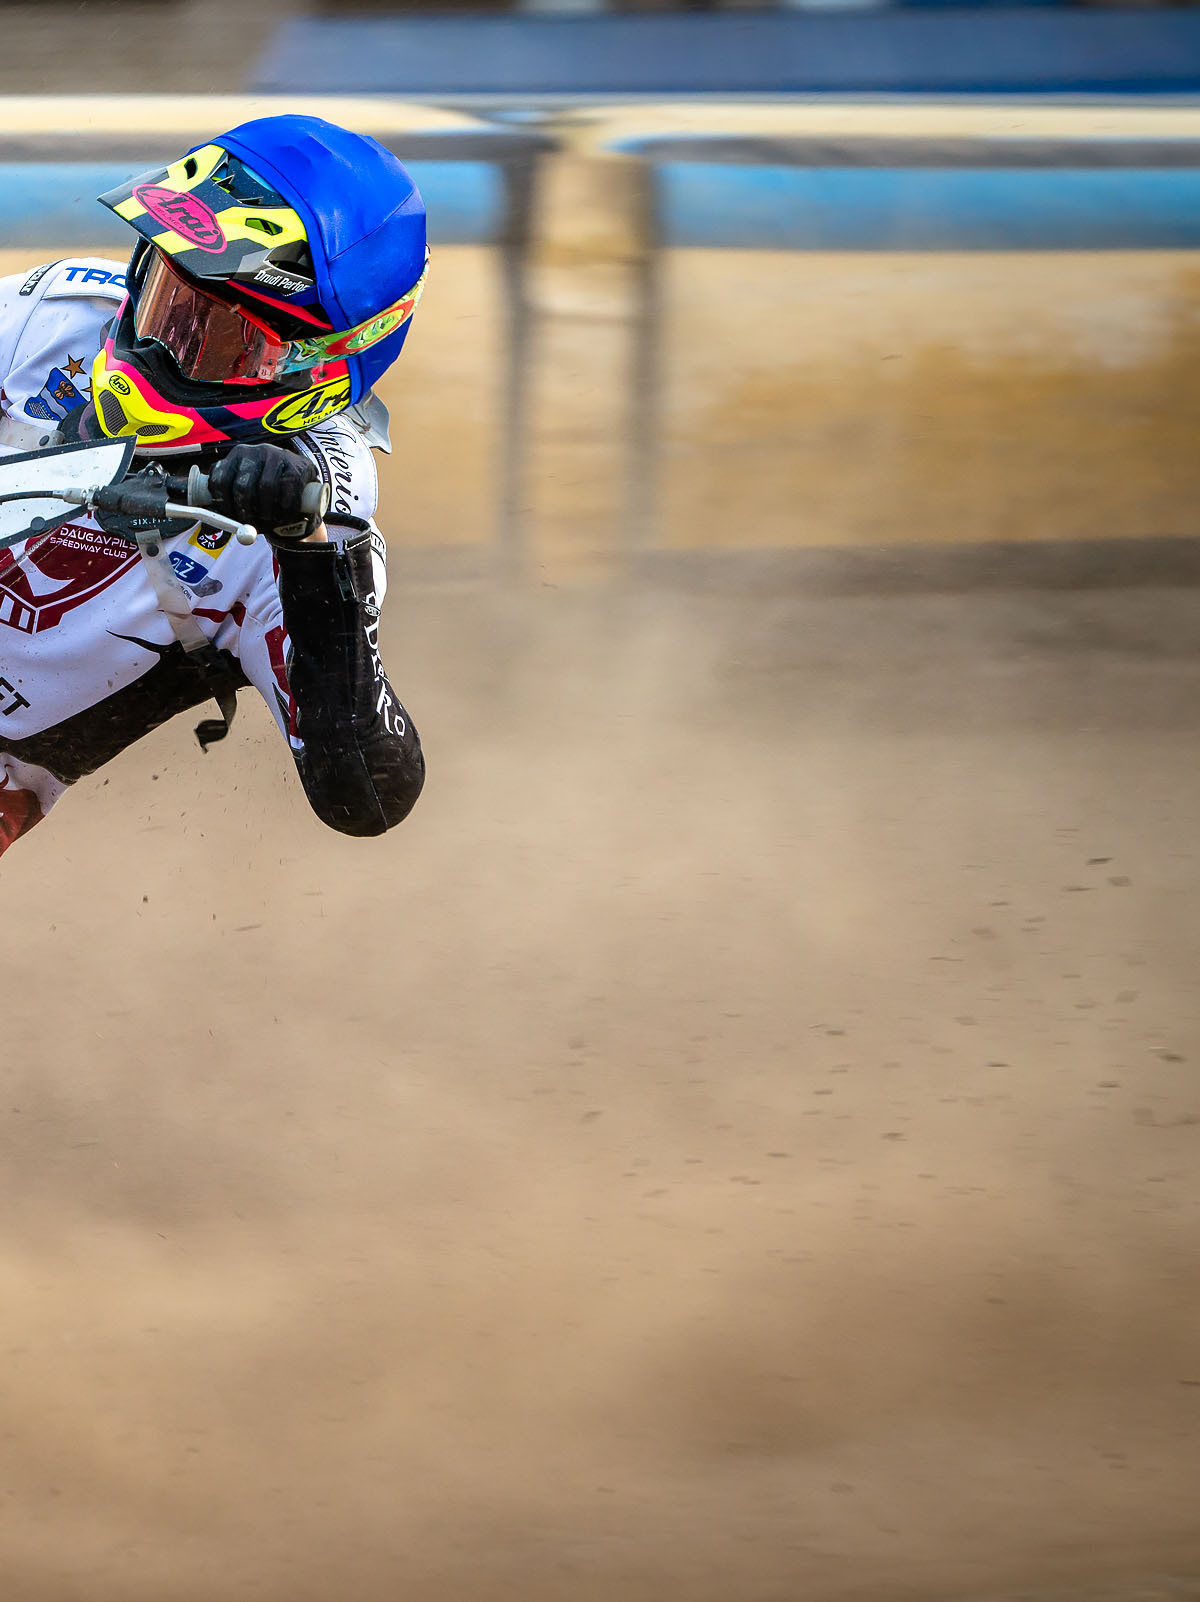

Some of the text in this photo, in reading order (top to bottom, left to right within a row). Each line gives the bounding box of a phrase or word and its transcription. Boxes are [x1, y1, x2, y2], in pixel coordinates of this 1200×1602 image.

[137, 190, 219, 240] Arai
[49, 536, 128, 559] SPEEDWAY CLUB
[60, 527, 138, 550] DAUGAVPILS
[198, 535, 215, 549] PZM
